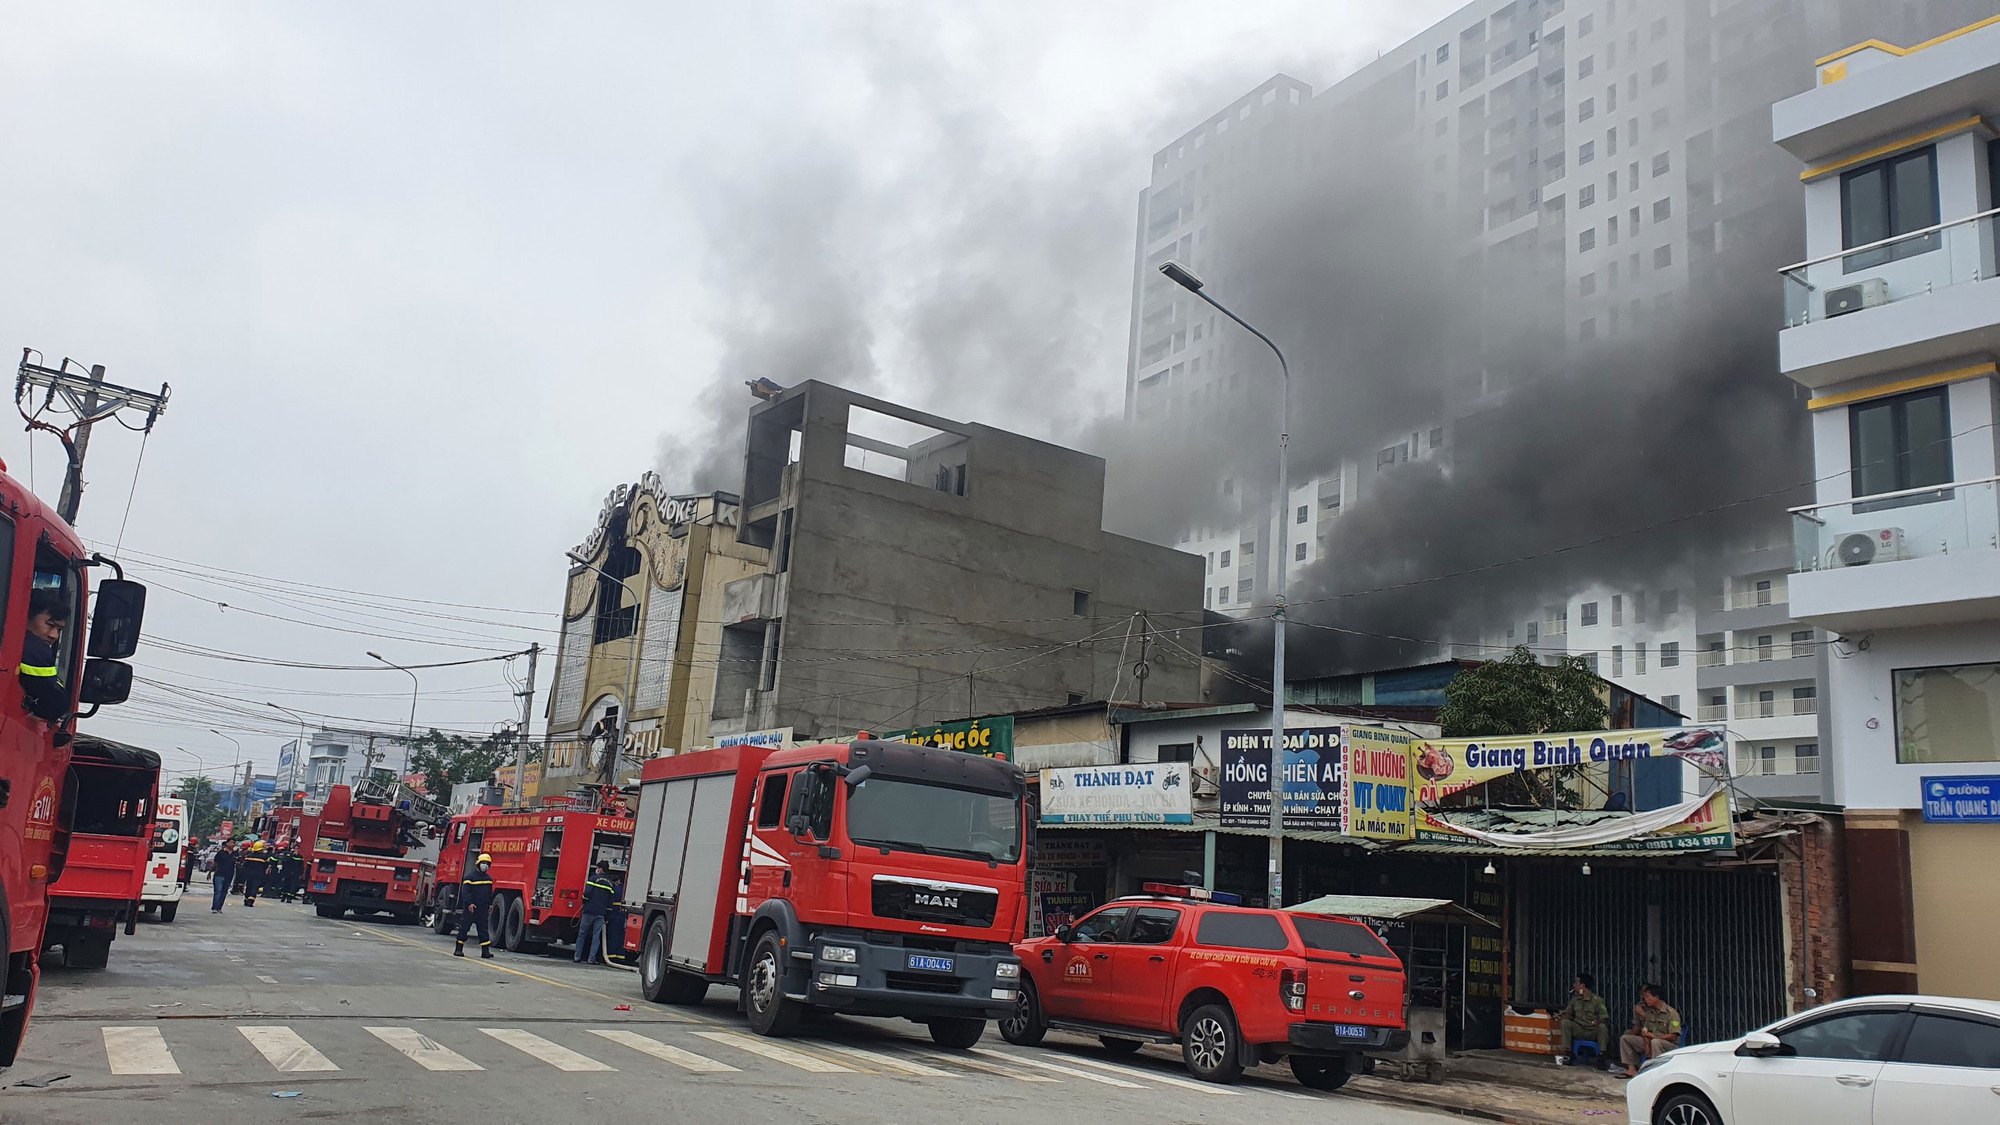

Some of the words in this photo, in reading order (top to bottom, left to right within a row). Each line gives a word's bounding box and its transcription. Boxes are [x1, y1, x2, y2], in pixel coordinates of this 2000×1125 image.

[641, 471, 697, 524] KARAOKE
[720, 736, 738, 748] QUÁN
[750, 733, 767, 747] PHÚC
[768, 731, 784, 746] HẬU
[967, 720, 990, 748] ỐC
[1227, 733, 1259, 752] ĐIỆN
[1262, 735, 1304, 752] TOẠI
[1308, 734, 1324, 748] DI
[1328, 733, 1341, 748] Đ
[1352, 729, 1373, 740] GIANG
[1353, 745, 1368, 775] GÀ
[1371, 748, 1406, 779] NƯỚNG
[1465, 743, 1526, 773] Giang
[1533, 738, 1581, 765] Bình
[1589, 737, 1651, 762] Quán
[1225, 756, 1267, 782] HỒNG
[1282, 759, 1318, 782] HIÊN
[1074, 769, 1121, 787] THÀNH
[1124, 770, 1155, 789] ĐẠT
[1294, 791, 1310, 801] BÁN
[1353, 781, 1374, 814] VỊT
[1376, 783, 1407, 814] QUAY
[1948, 783, 1991, 795] ĐƯỜNG
[40, 796, 52, 820] 114
[1067, 813, 1091, 821] THAY
[1093, 810, 1111, 821] THẾ
[1134, 811, 1161, 822] TÙNG
[1223, 801, 1231, 812] ÉP
[1232, 801, 1249, 813] KÍNH
[1254, 804, 1271, 813] THAY
[1290, 803, 1309, 814] HÌNH
[1314, 805, 1336, 816] CHẠY
[1927, 797, 1953, 816] TRẦN
[1955, 799, 1988, 818] QUANG
[1991, 799, 2000, 816] DI
[595, 817, 608, 828] XE
[1388, 820, 1406, 837] MẬT
[1678, 838, 1700, 848] 434
[1702, 835, 1726, 846] 997
[914, 893, 958, 908] MAN
[1075, 963, 1087, 975] 114
[1312, 1004, 1396, 1019] RANGER
